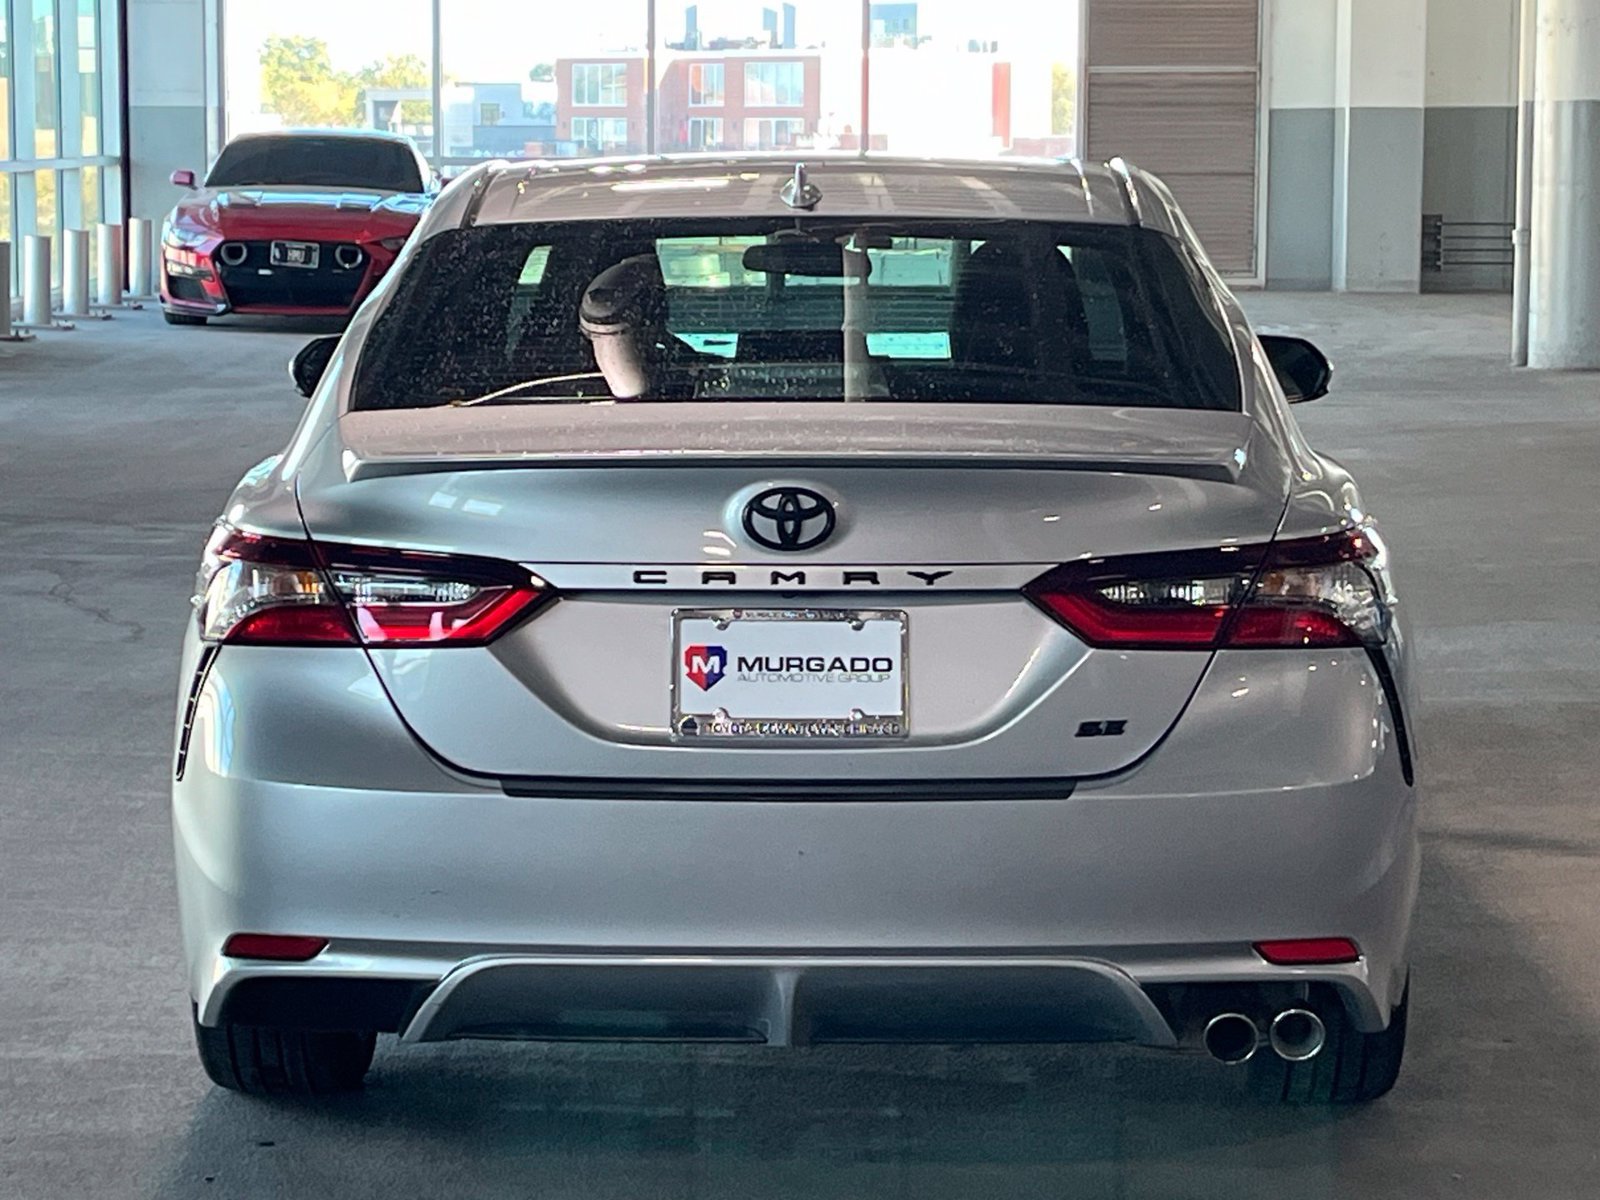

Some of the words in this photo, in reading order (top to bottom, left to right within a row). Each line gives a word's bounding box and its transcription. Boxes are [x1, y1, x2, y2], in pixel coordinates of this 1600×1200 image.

[633, 570, 954, 586] CAMRY
[691, 655, 721, 674] M
[736, 657, 893, 673] MURGADO
[737, 672, 834, 683] AUTOMOTIVE
[837, 673, 891, 683] GROUP
[1074, 719, 1128, 738] SE
